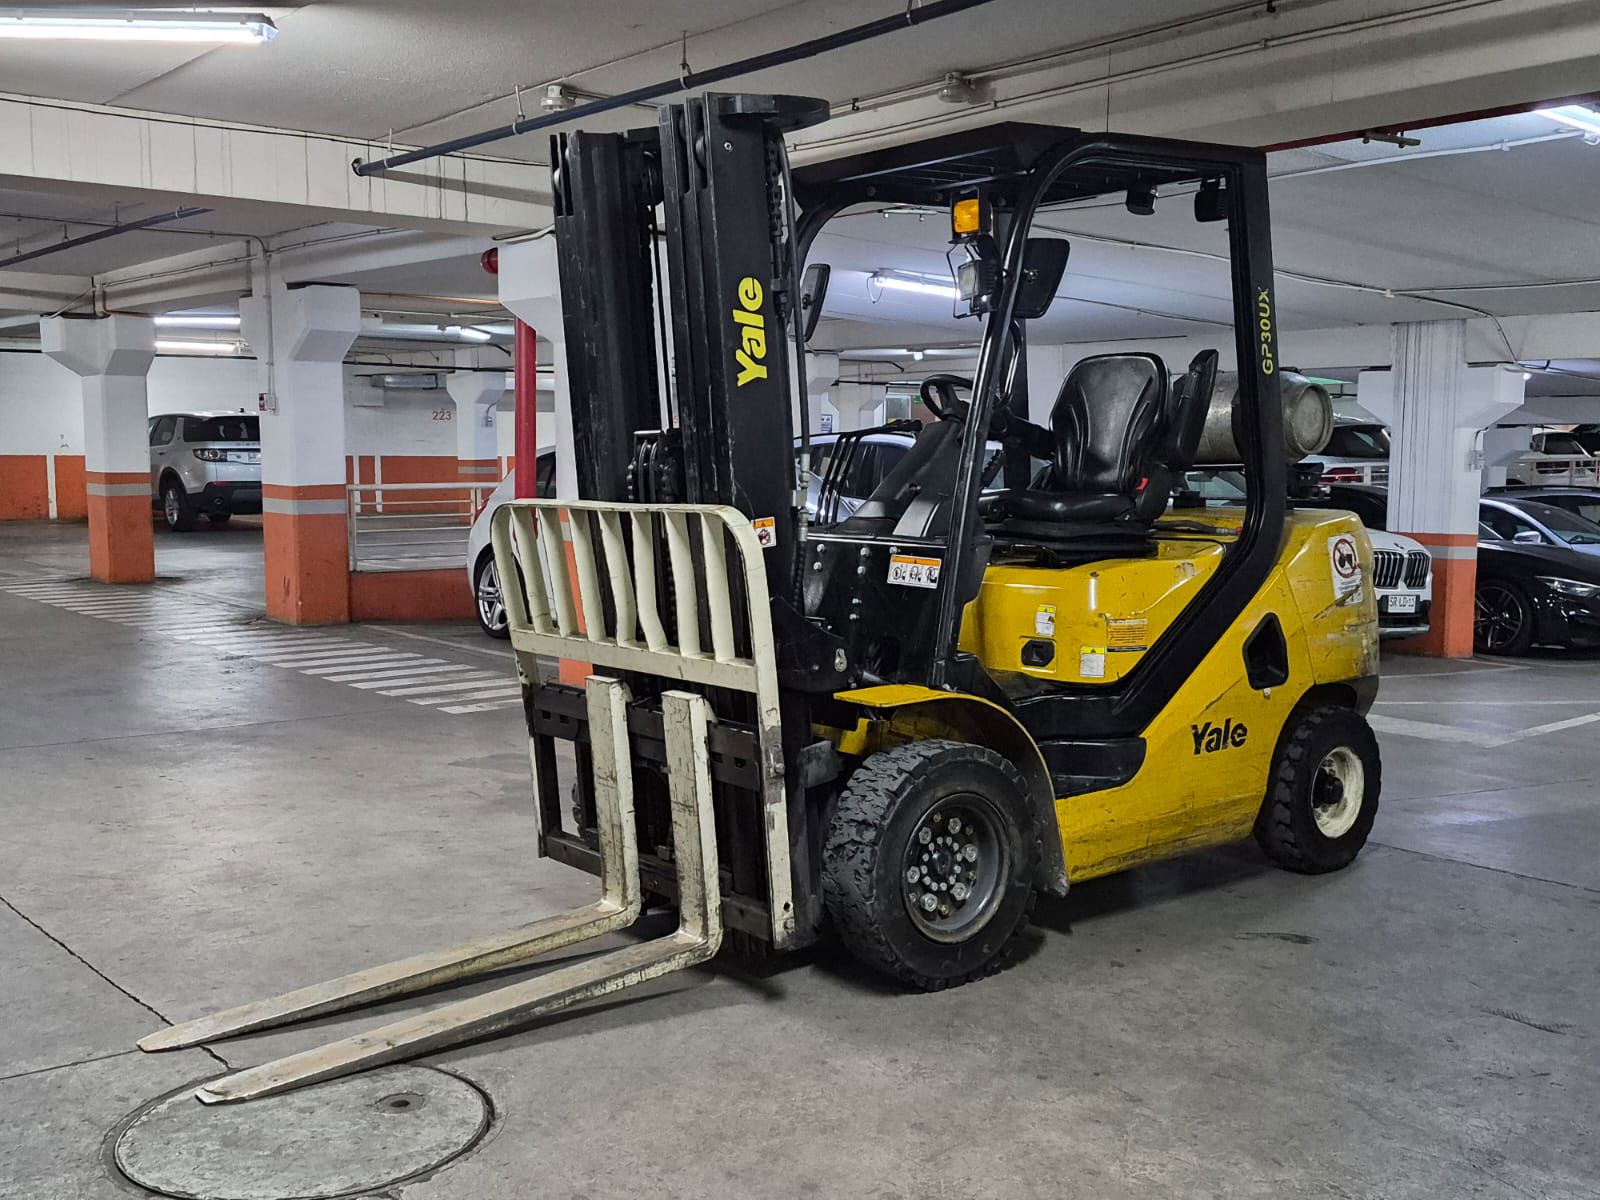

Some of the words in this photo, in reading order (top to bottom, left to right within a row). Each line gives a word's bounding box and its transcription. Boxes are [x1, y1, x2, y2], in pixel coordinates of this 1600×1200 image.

[732, 276, 768, 387] Yale
[1258, 286, 1274, 375] GP30UX
[432, 410, 451, 421] 223
[1190, 717, 1248, 756] Yale
